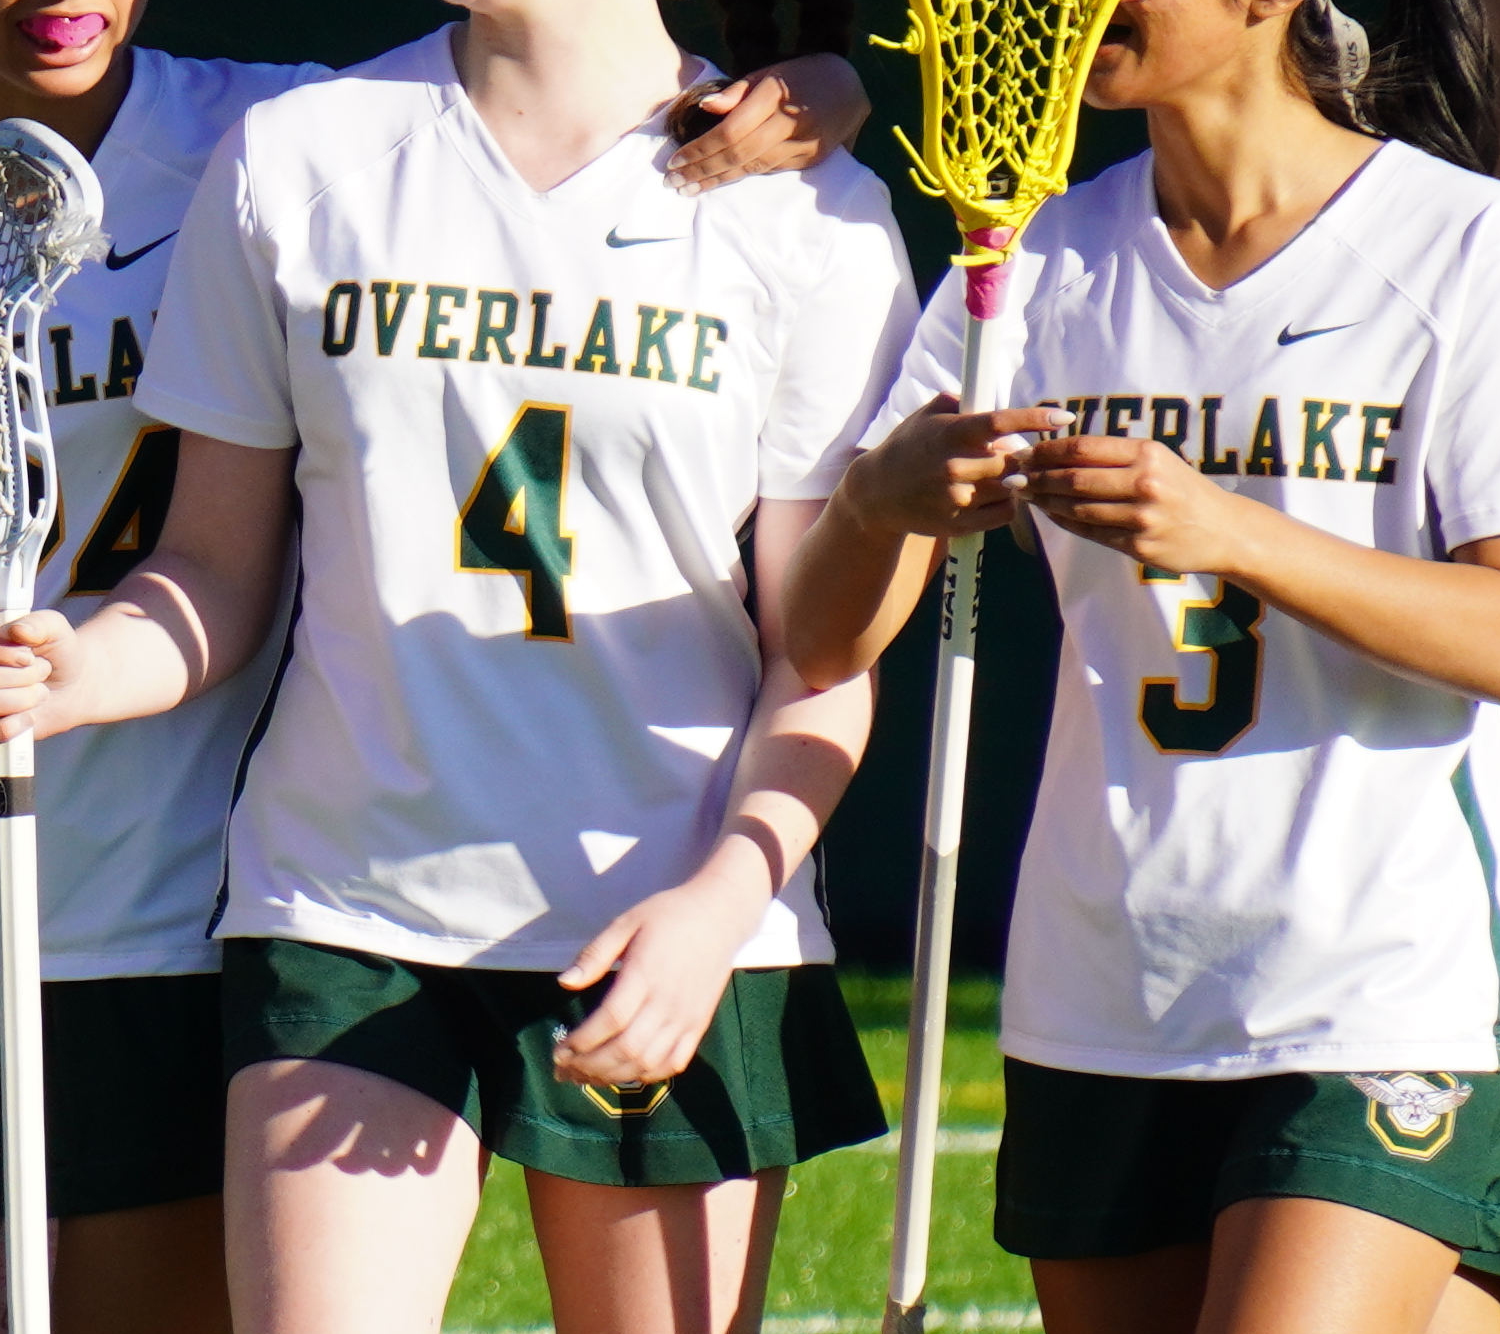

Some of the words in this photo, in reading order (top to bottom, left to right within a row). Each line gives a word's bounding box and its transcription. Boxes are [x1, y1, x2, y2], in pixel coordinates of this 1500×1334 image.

[323, 280, 729, 394] OVERLAKE
[1036, 393, 1405, 485] VERLAKE
[454, 400, 575, 643] 4
[1137, 559, 1268, 758] 3
